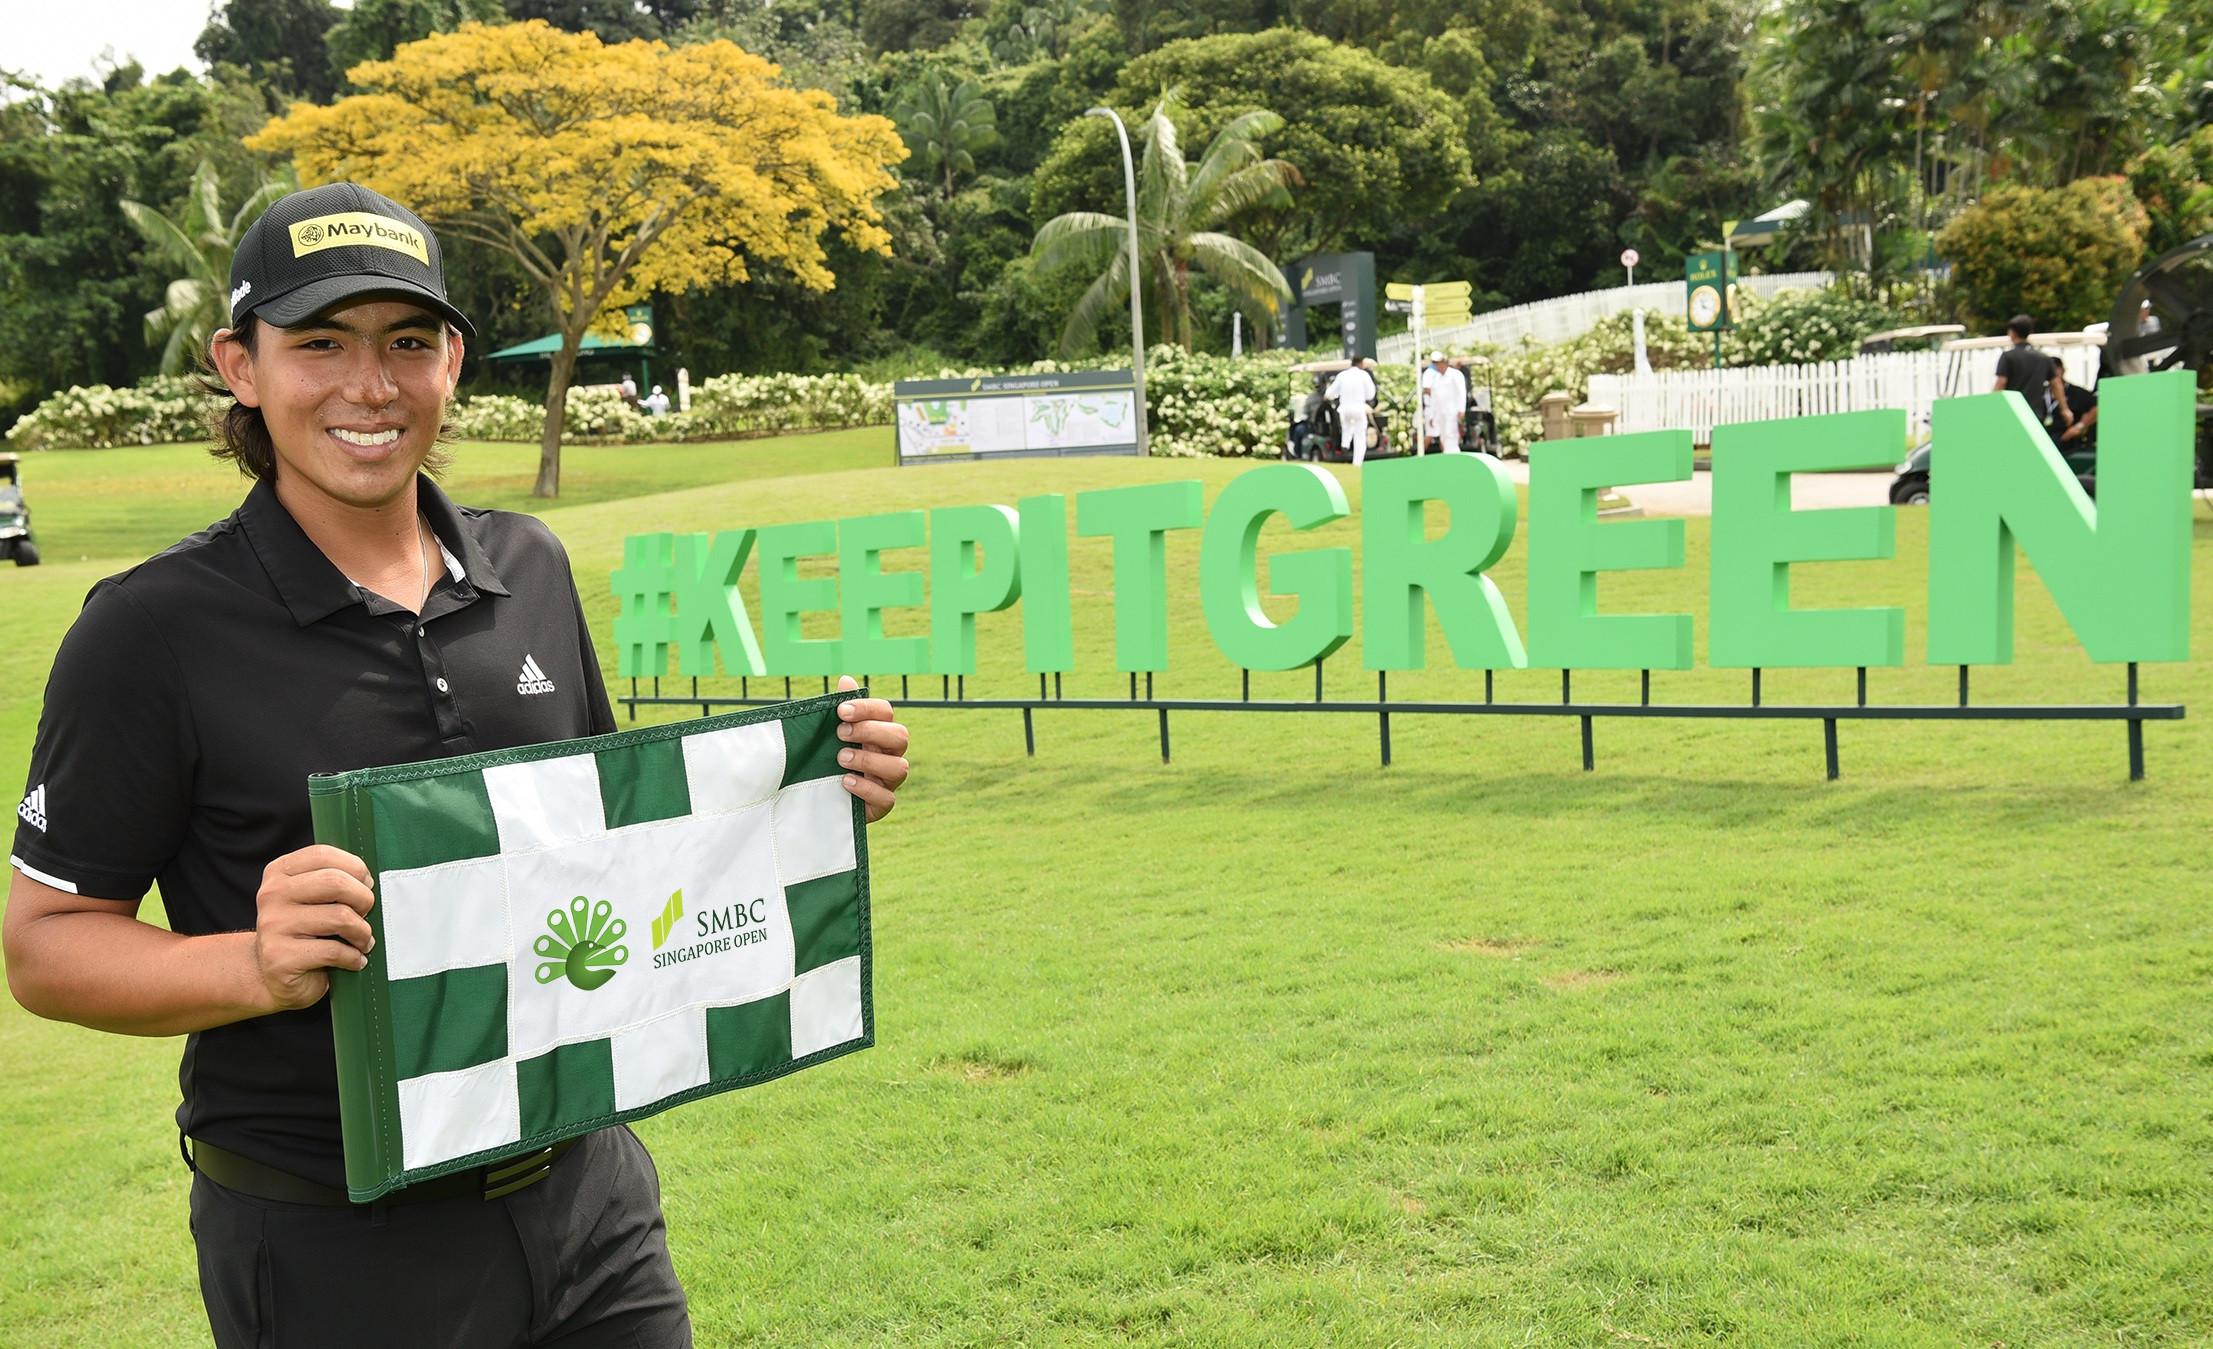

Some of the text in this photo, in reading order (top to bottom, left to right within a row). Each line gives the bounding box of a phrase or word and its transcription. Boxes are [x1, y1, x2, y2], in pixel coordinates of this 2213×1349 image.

[328, 222, 418, 249] Maybank
[610, 369, 2197, 677] #KEEPITGREEN
[517, 679, 556, 695] adidas
[697, 898, 766, 936] SMBC
[653, 928, 768, 968] SINGAPORE OPEN
